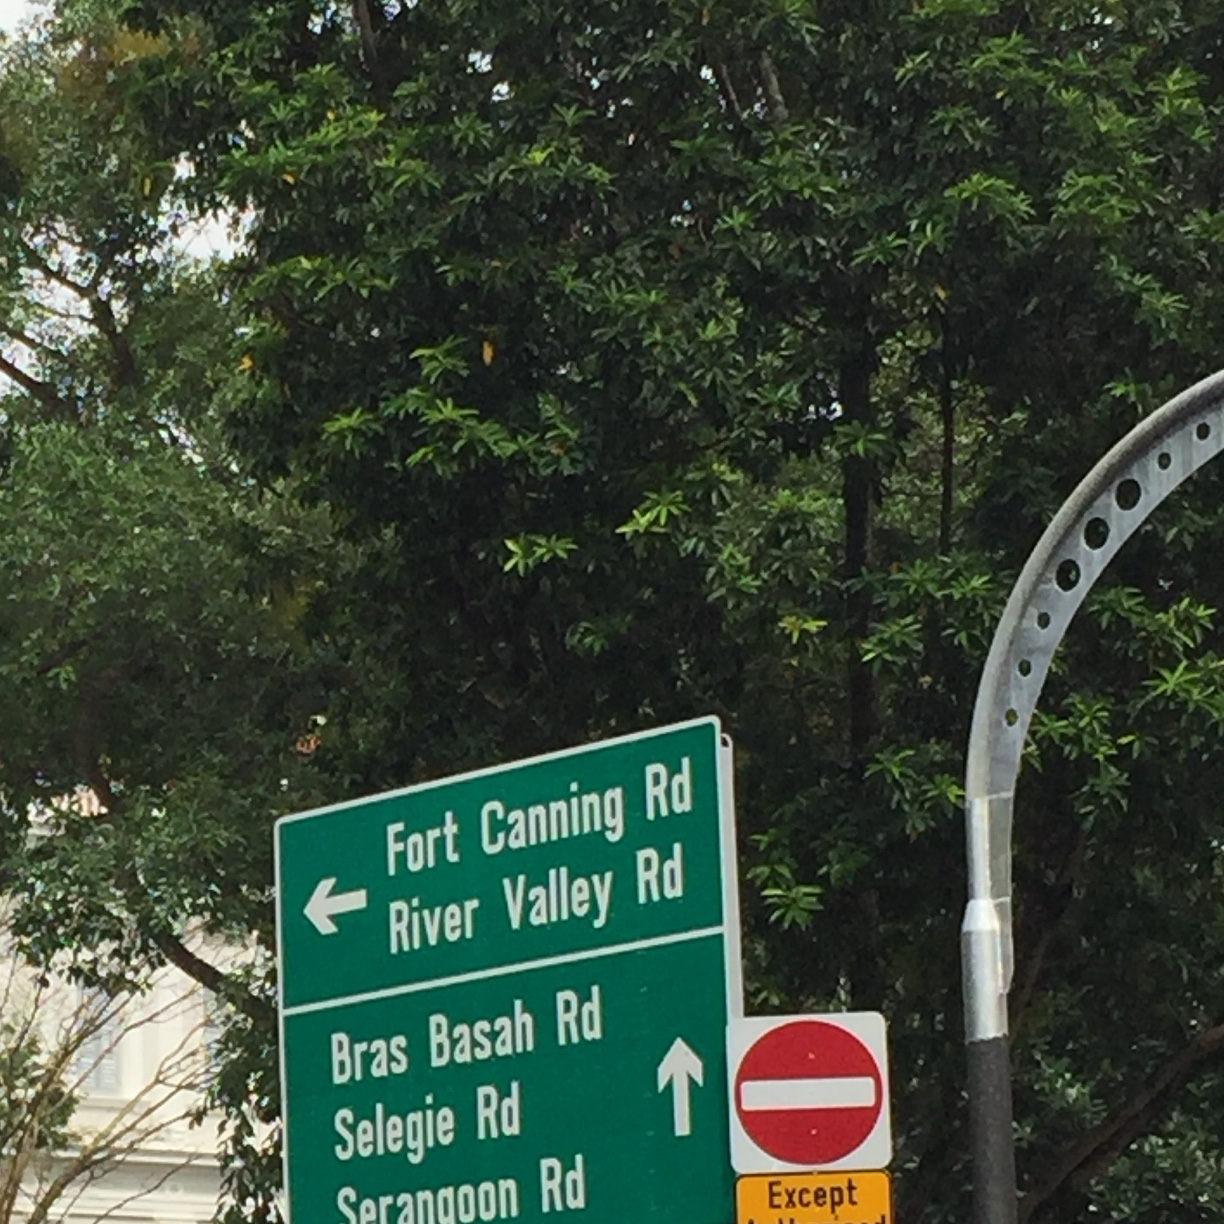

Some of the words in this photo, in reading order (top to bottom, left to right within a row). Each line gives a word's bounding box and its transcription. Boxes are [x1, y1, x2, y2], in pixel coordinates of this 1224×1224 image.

[387, 812, 459, 876] Fort
[481, 783, 624, 855] Canning
[645, 756, 692, 820] Rd
[389, 899, 479, 954] River
[503, 867, 613, 928] Valley
[636, 843, 683, 904] Rd
[331, 1033, 408, 1084] Bras
[429, 1000, 534, 1067] Basah
[556, 985, 602, 1045] Rd
[334, 1095, 455, 1164] Selegie
[477, 1081, 520, 1140] Rd
[540, 1154, 585, 1213] Rd
[768, 1177, 858, 1215] Except
